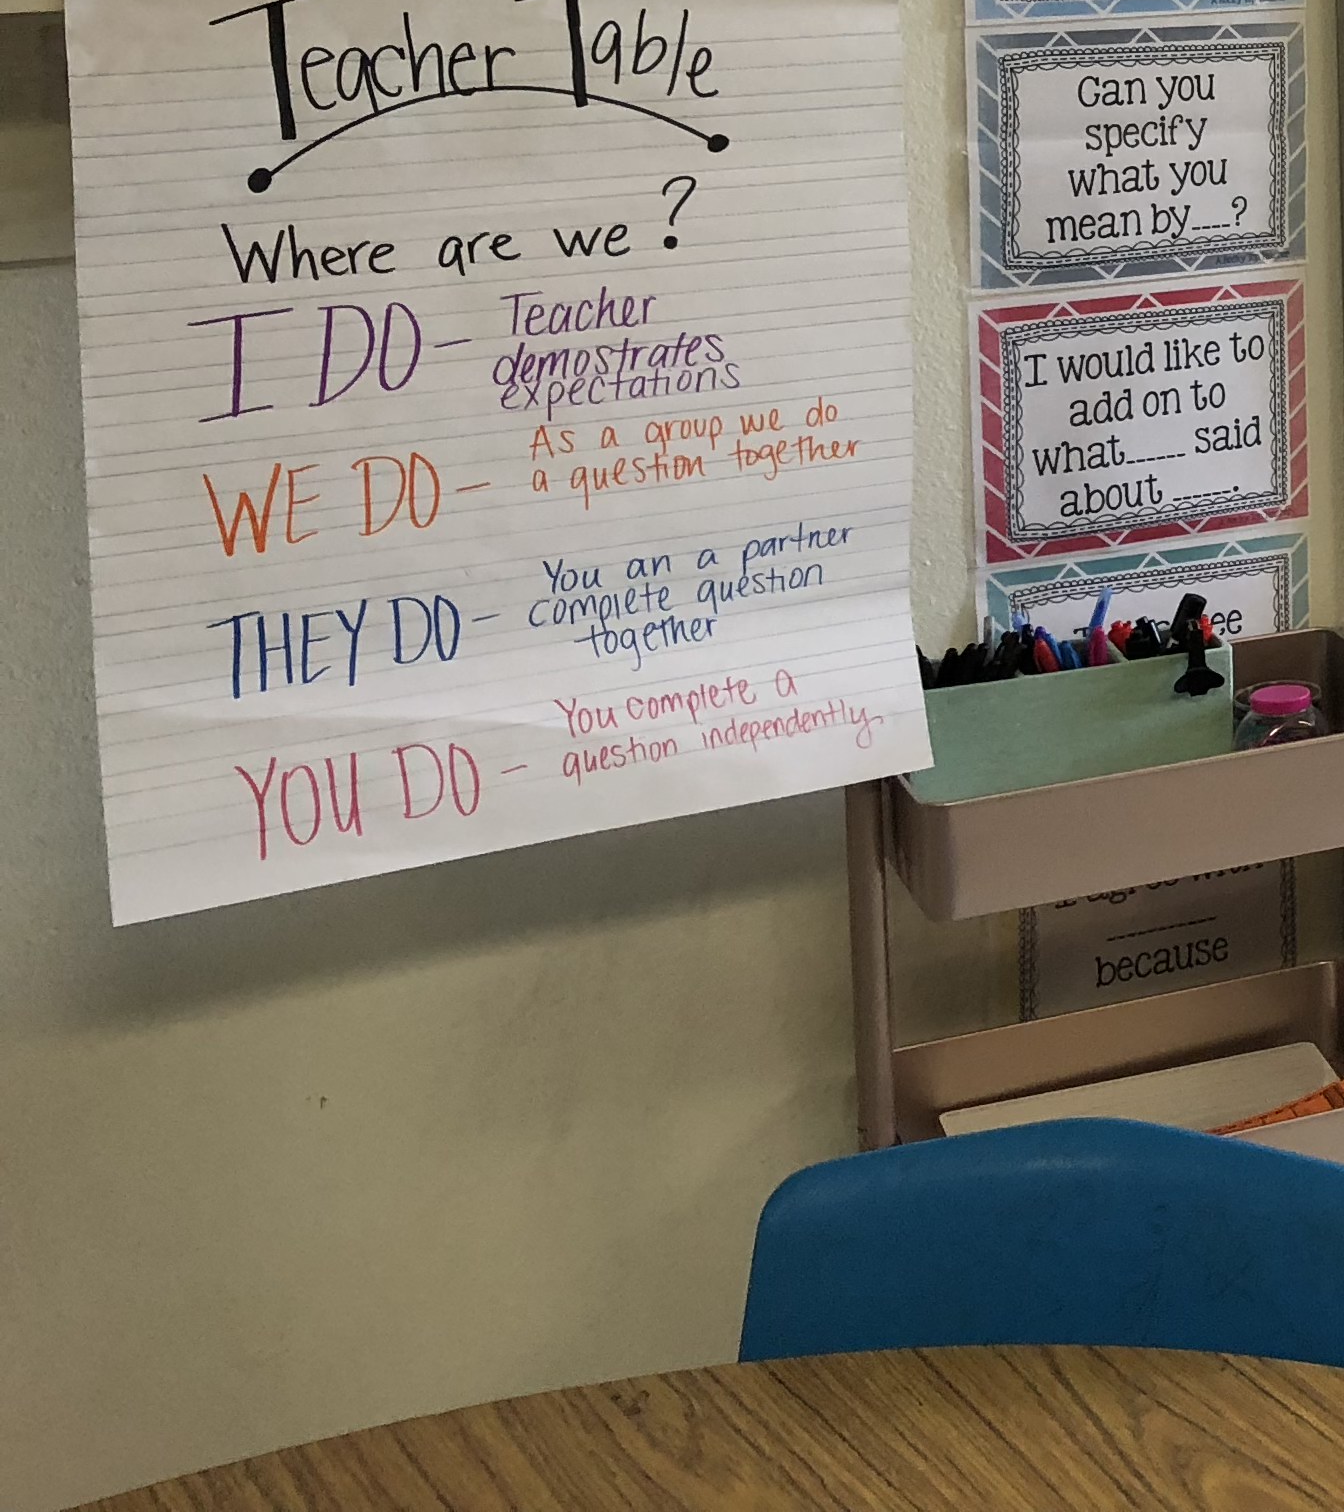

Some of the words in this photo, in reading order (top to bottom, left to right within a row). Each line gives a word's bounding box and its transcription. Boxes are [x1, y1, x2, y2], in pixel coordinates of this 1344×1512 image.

[1077, 75, 1146, 108] Can
[1156, 73, 1215, 110] you
[1085, 114, 1208, 158] specify
[1068, 159, 1159, 197] what
[1169, 158, 1228, 196] you
[221, 222, 395, 284] Where
[438, 231, 521, 276] are
[1045, 208, 1141, 244] mean
[501, 286, 656, 336] Teacher
[187, 308, 294, 423] I
[493, 331, 725, 386] demostrates
[1024, 353, 1048, 388] I
[1057, 340, 1155, 384] would
[1164, 338, 1221, 372] like
[1229, 332, 1265, 362] to
[500, 362, 740, 420] expectations
[1069, 388, 1133, 427] add
[1142, 386, 1181, 418] on
[1190, 379, 1226, 410] to
[529, 424, 575, 460] As
[600, 425, 619, 449] a
[645, 416, 723, 454] group
[740, 407, 784, 436] we
[805, 397, 838, 428] do
[1194, 415, 1262, 454] said
[532, 468, 549, 493] a
[570, 452, 705, 510] question
[730, 434, 860, 480] together
[1060, 473, 1163, 519] about
[203, 463, 320, 556] WE
[542, 558, 603, 595] You
[626, 555, 671, 580] an
[698, 548, 718, 569] a
[742, 522, 854, 574] partner
[528, 587, 670, 631] complete
[697, 561, 823, 615] question
[207, 599, 366, 699] THEY
[573, 616, 718, 671] together
[553, 698, 618, 738] You
[627, 677, 757, 722] complete
[775, 670, 797, 697] a
[563, 737, 677, 786] question
[701, 700, 884, 749] independently
[234, 752, 362, 860] YOU
[1095, 936, 1229, 988] because
